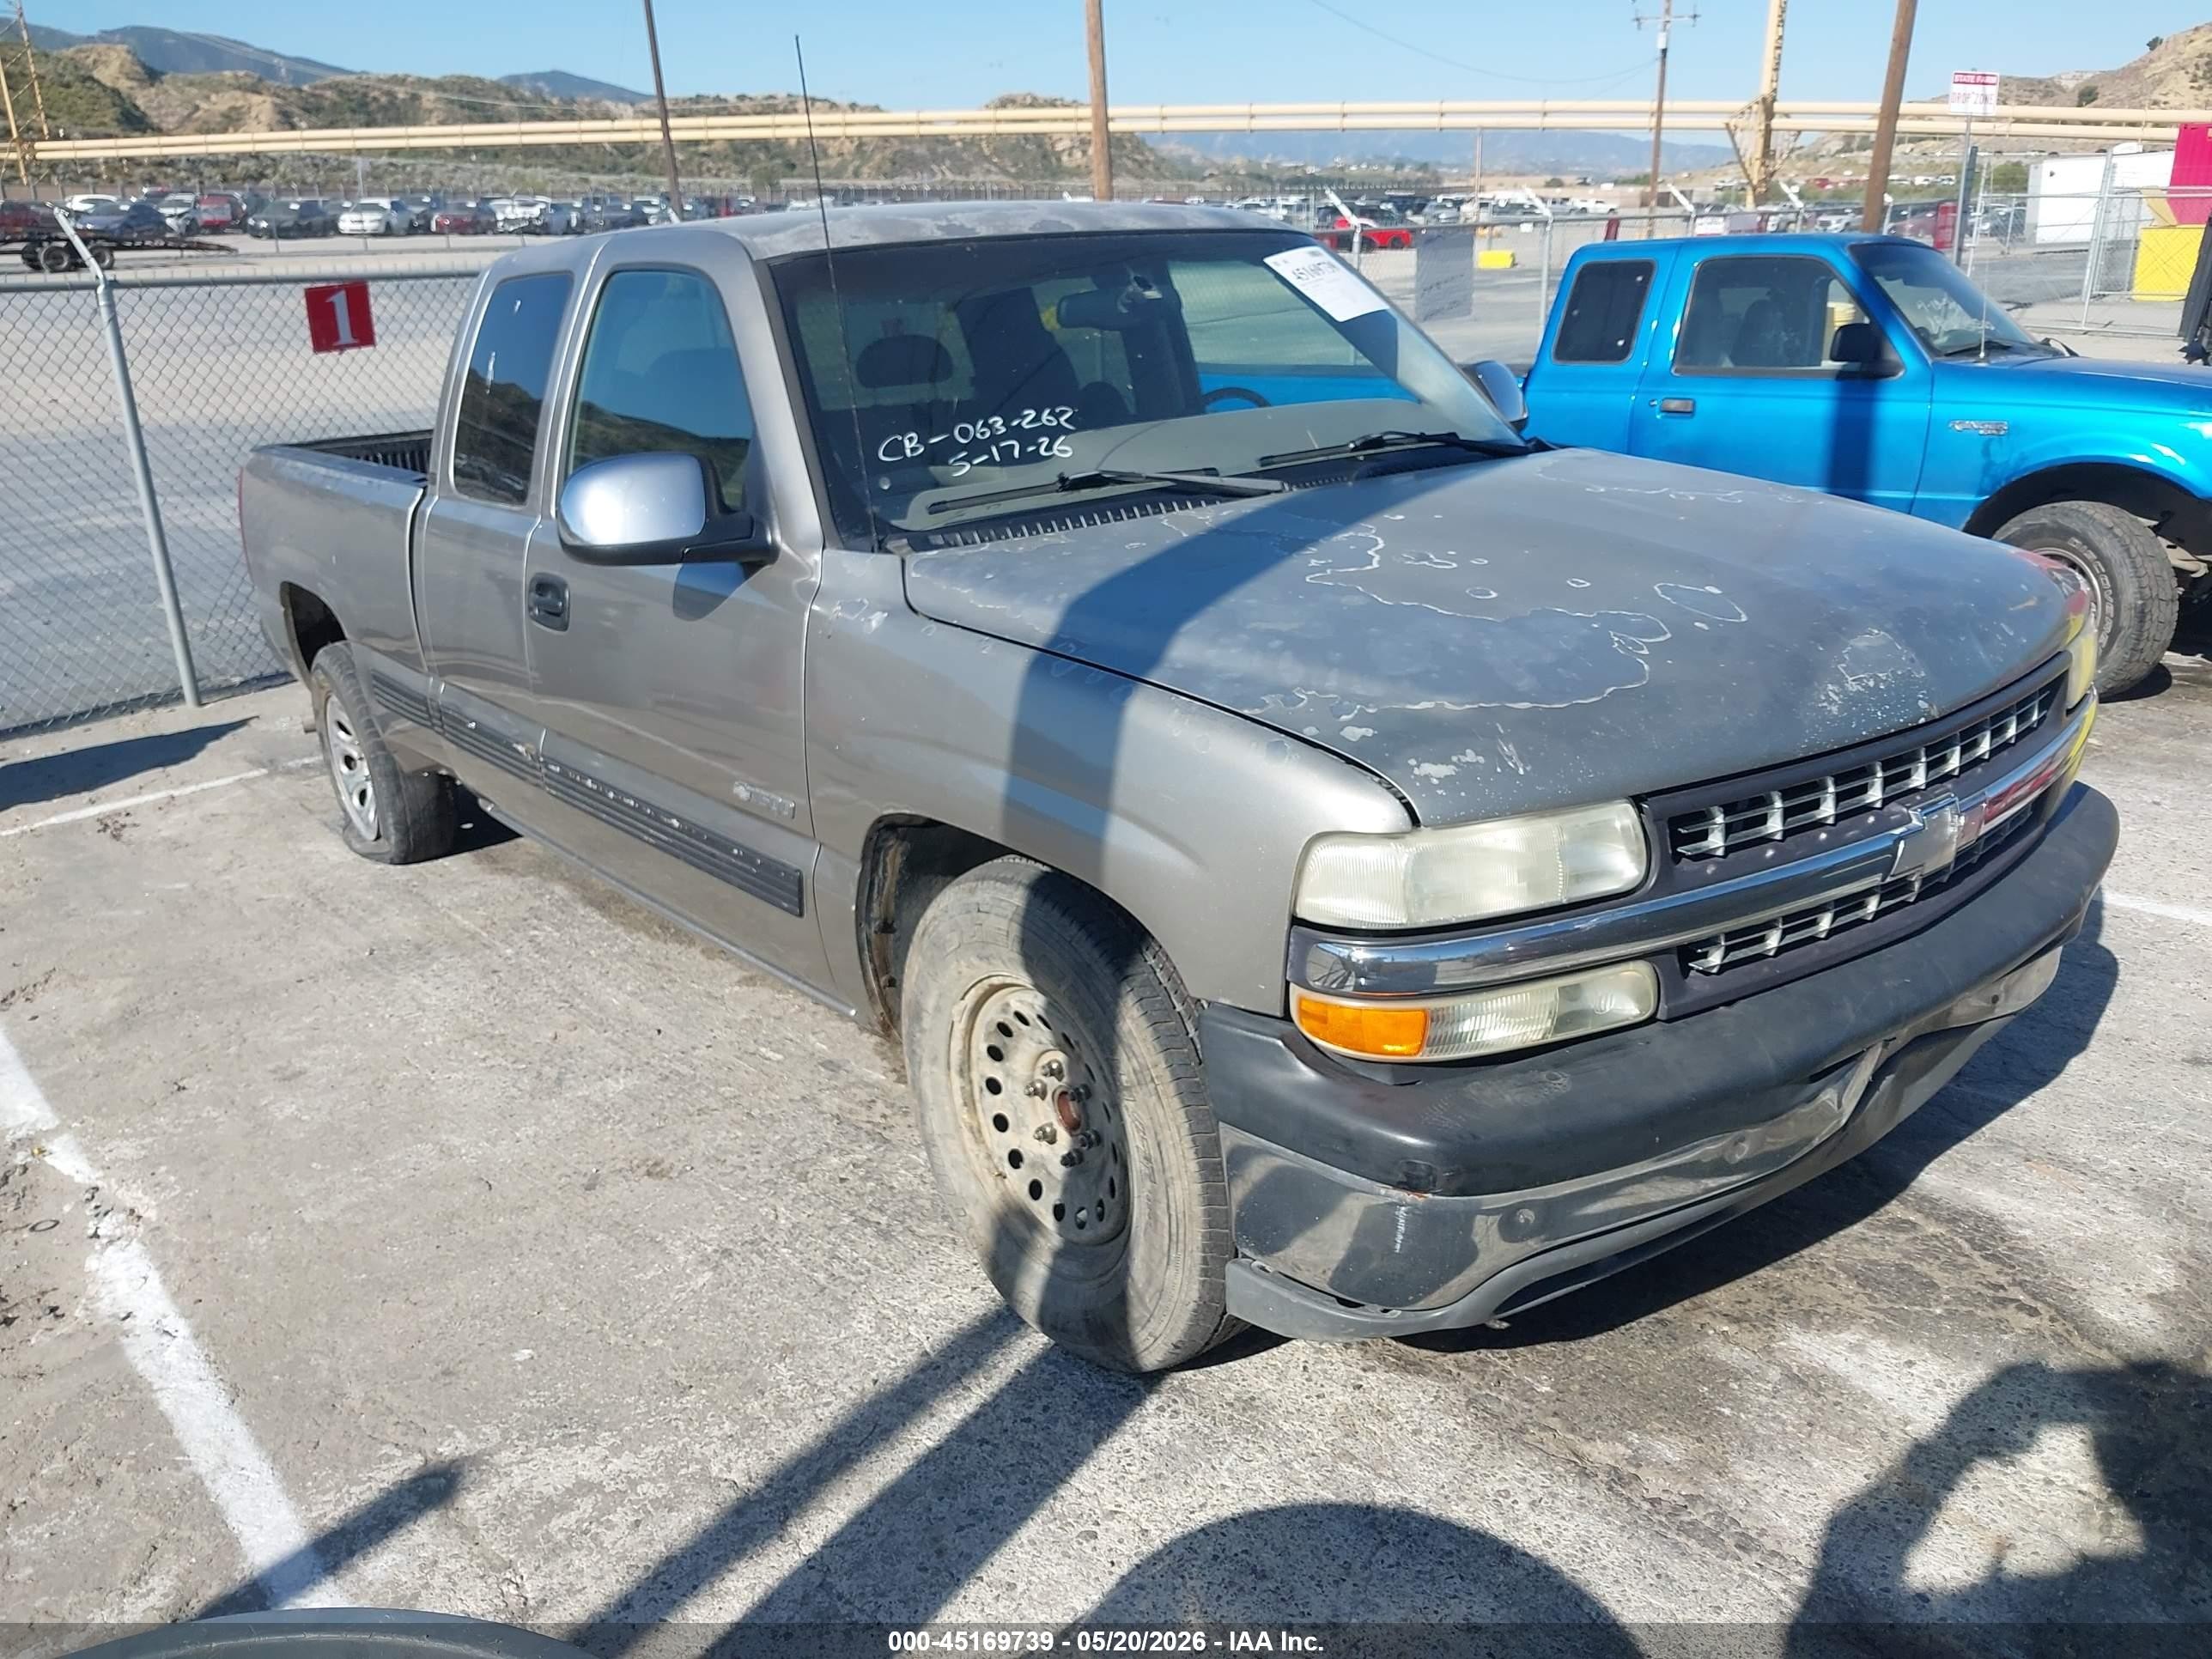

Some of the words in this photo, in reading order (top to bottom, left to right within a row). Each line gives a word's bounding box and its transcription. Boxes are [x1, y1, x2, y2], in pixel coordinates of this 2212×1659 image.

[1954, 74, 1976, 84] STATE
[325, 289, 359, 346] 1
[878, 406, 1077, 462] CB-063-262
[948, 435, 1073, 477] 5-17-26
